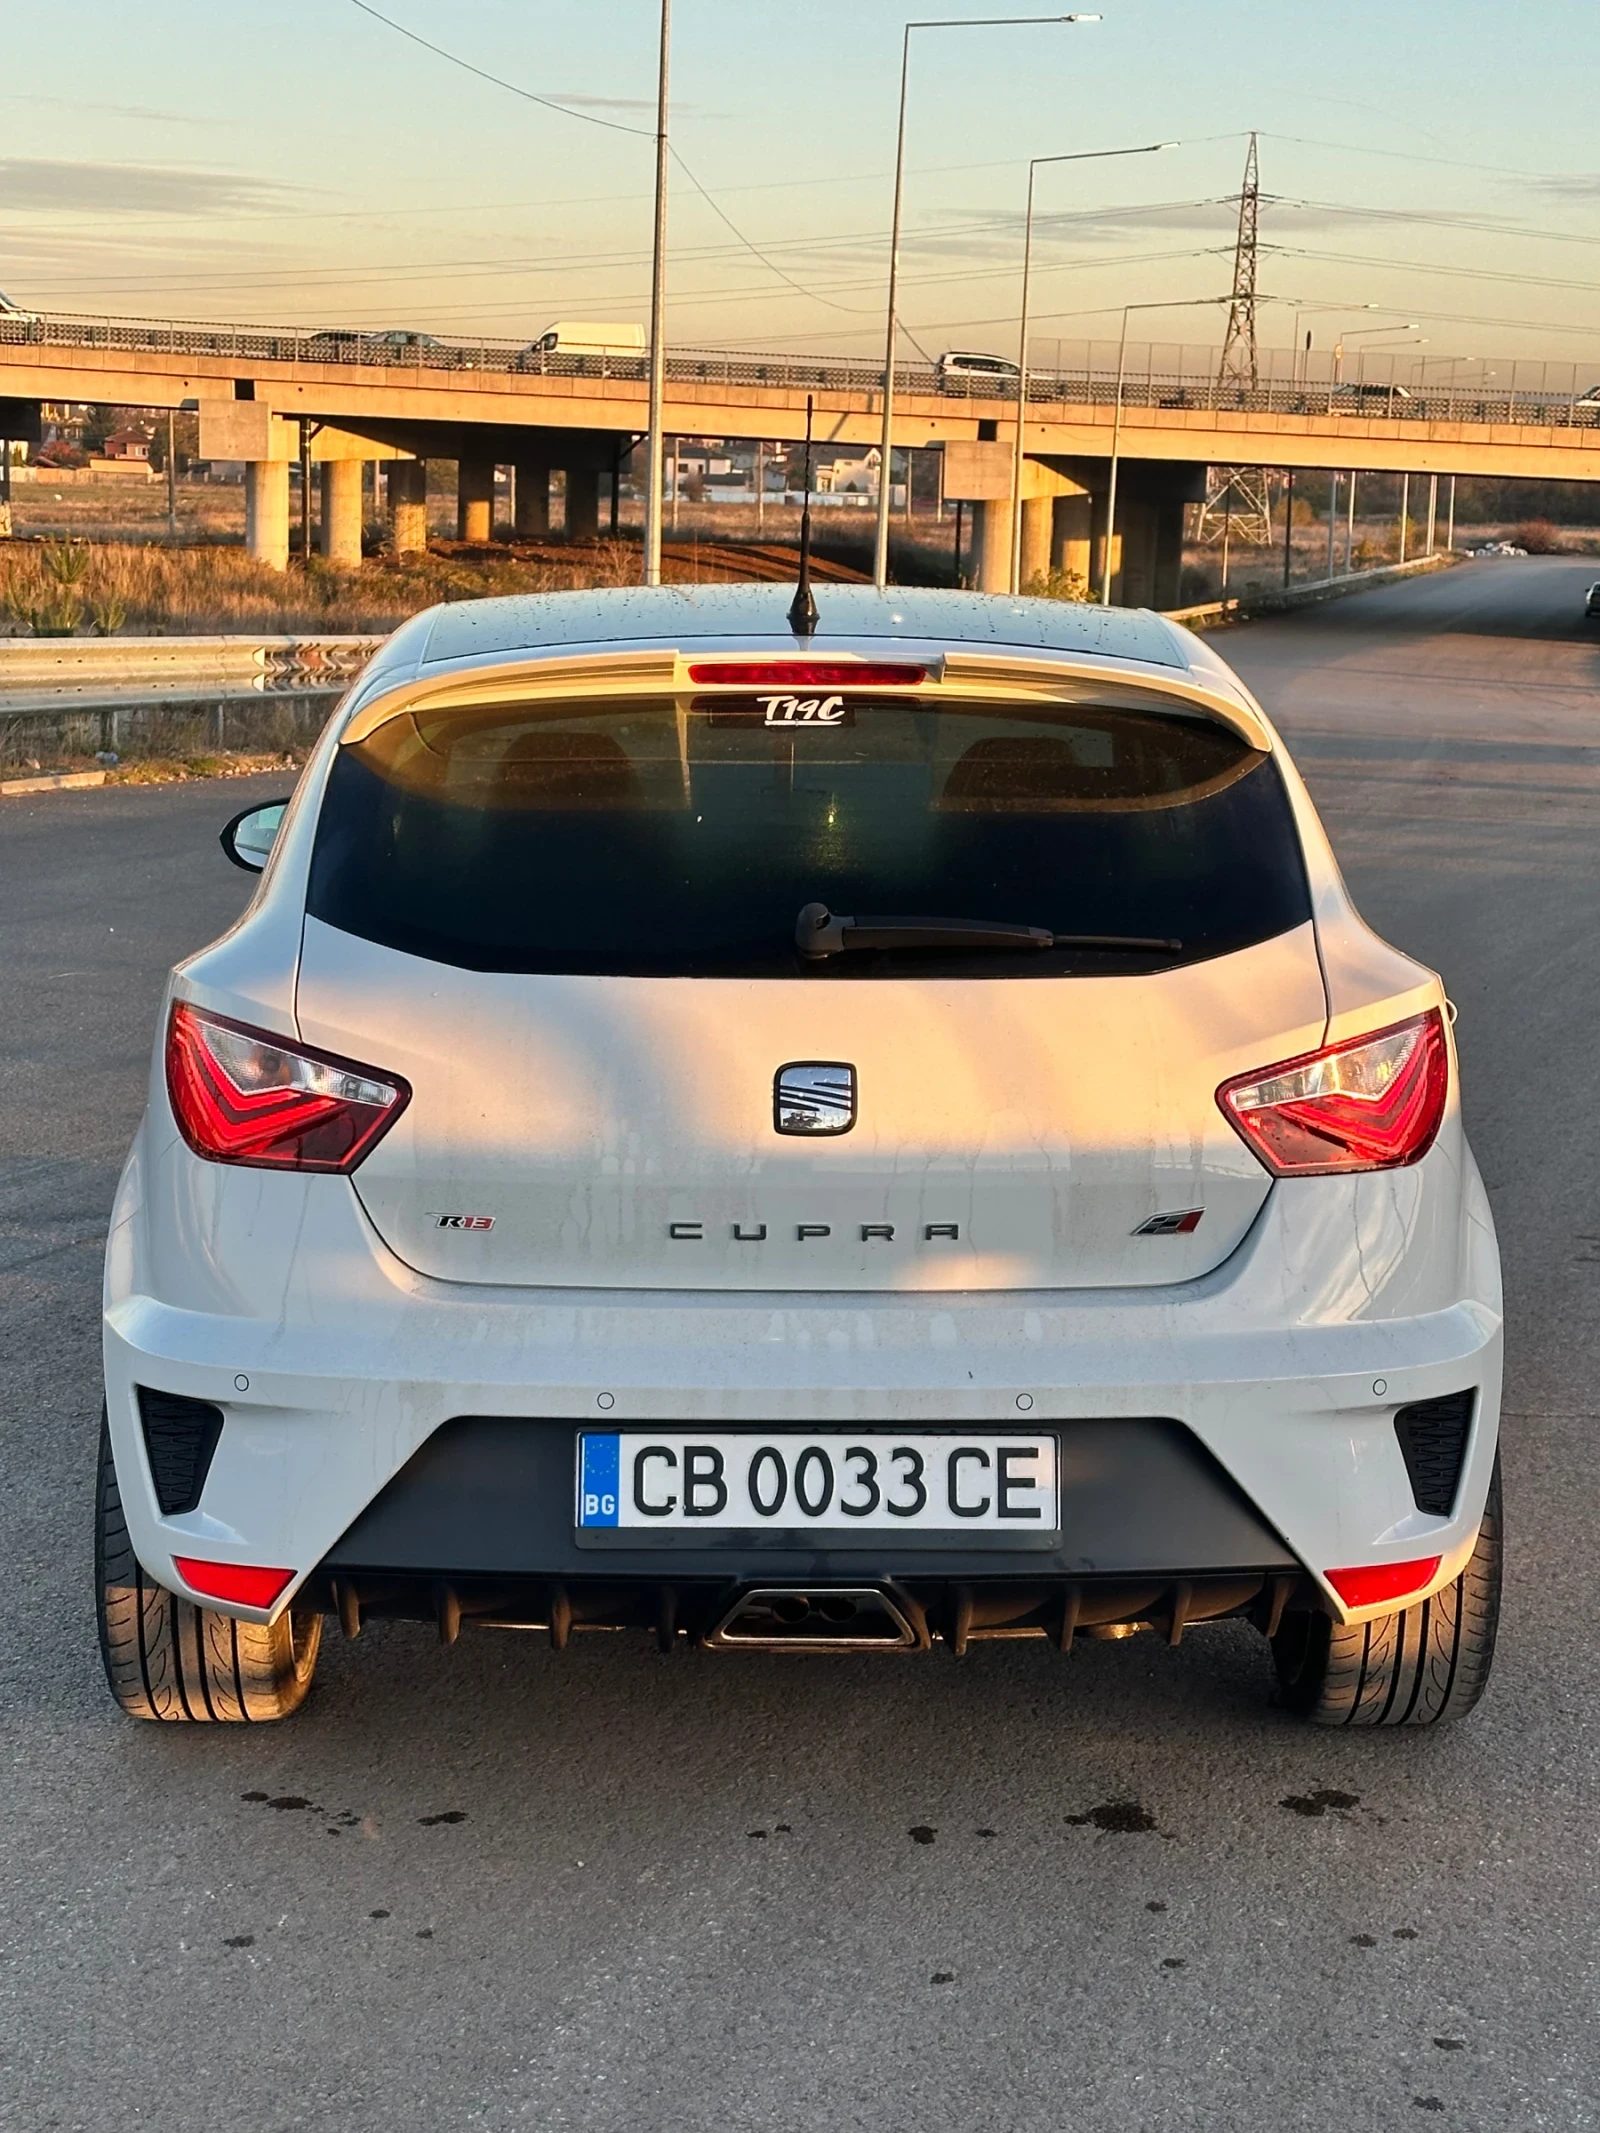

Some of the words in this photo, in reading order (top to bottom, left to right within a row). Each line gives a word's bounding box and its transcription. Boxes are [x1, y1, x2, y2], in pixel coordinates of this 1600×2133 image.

[438, 1215, 493, 1230] R13
[669, 1223, 958, 1241] CUPRA
[634, 1446, 727, 1517] CB
[748, 1446, 927, 1517] 0033
[947, 1447, 1042, 1518] CE
[585, 1494, 615, 1515] BG
